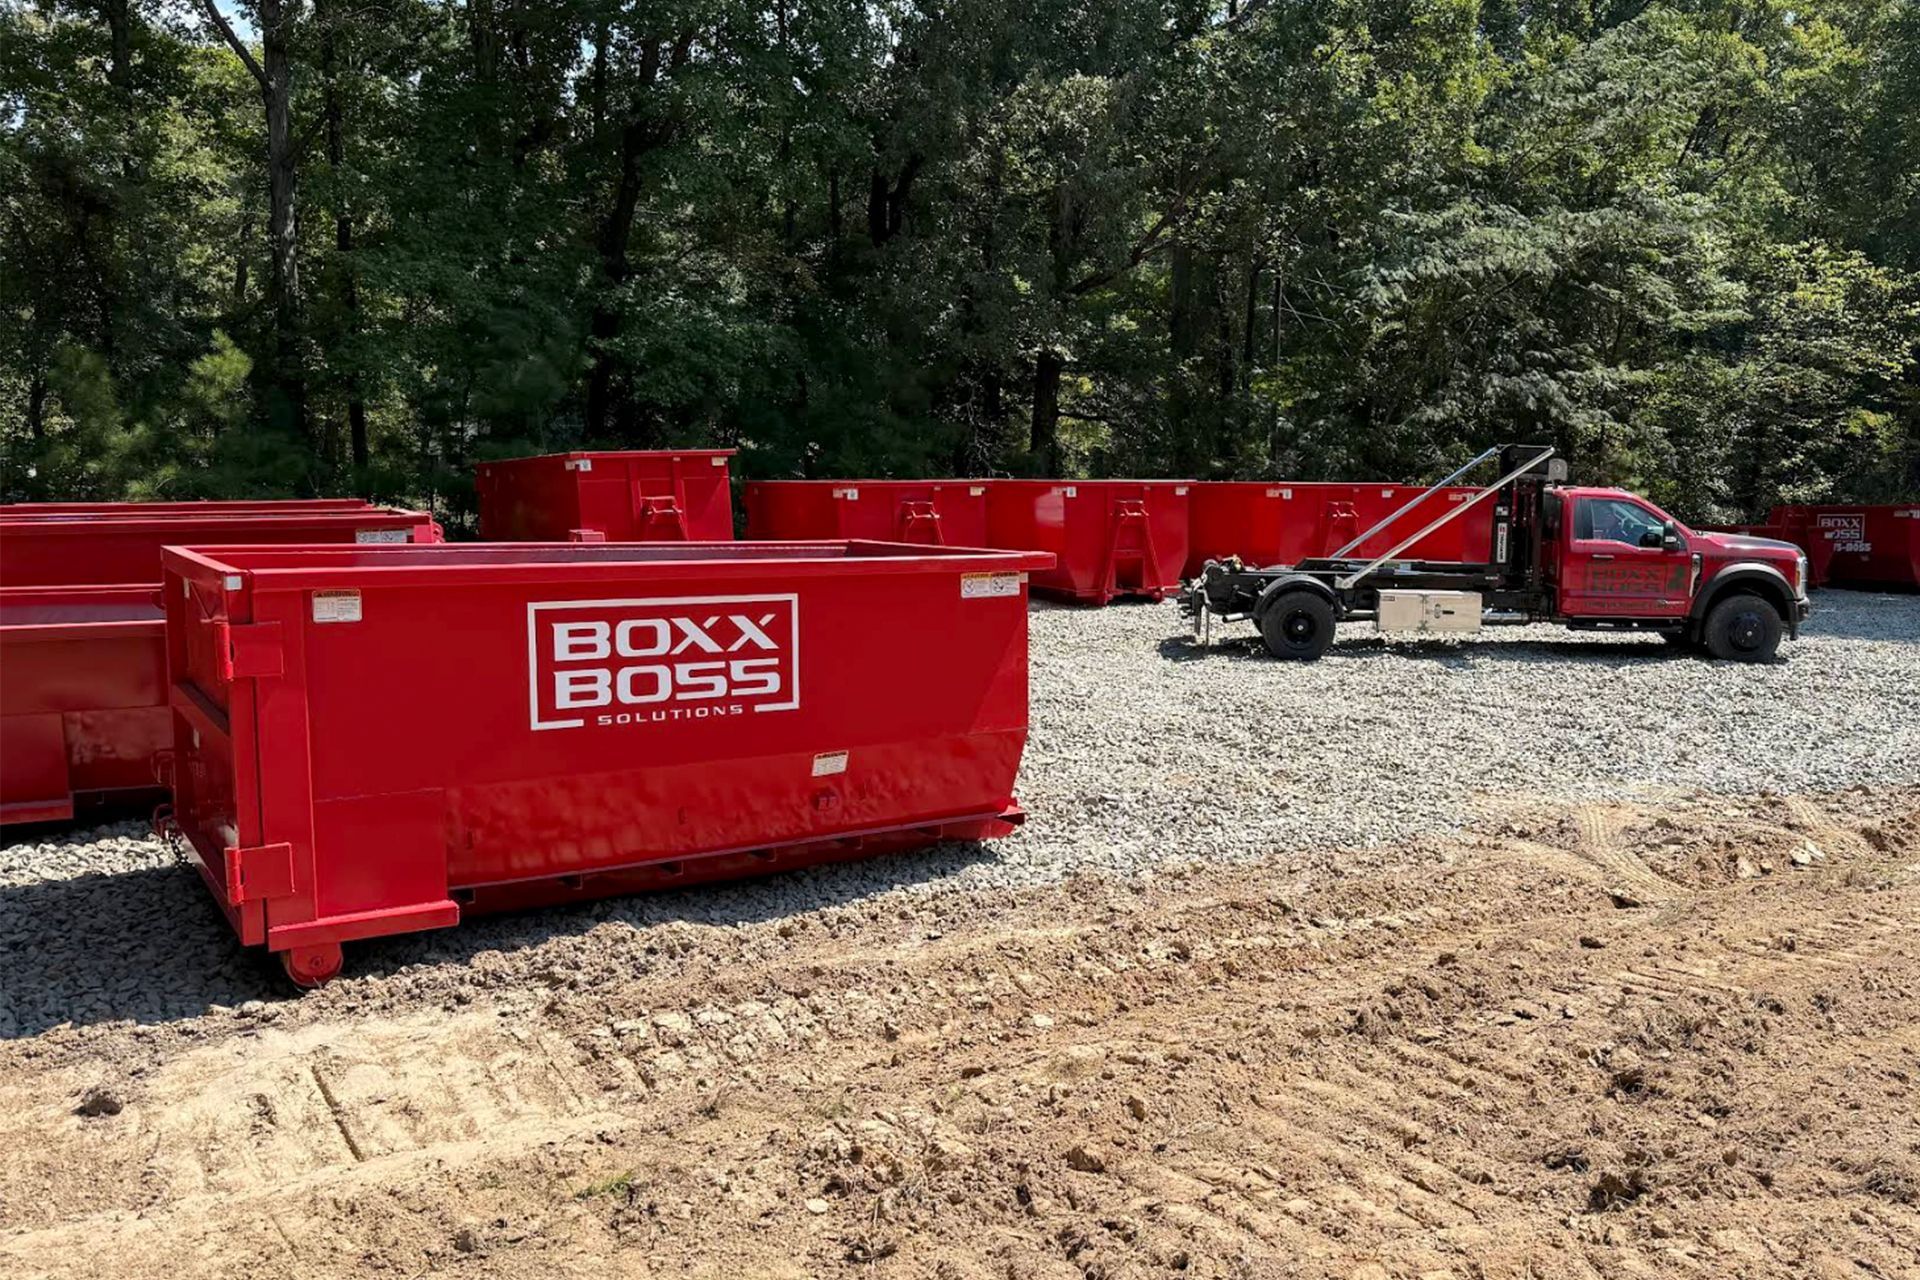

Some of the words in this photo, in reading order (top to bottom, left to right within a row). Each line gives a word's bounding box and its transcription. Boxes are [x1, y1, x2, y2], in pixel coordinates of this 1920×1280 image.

[1820, 518, 1861, 528] BOXX
[552, 614, 779, 661] BOXX
[553, 658, 781, 709] BOSS
[598, 705, 744, 725] SOLUTIONS
